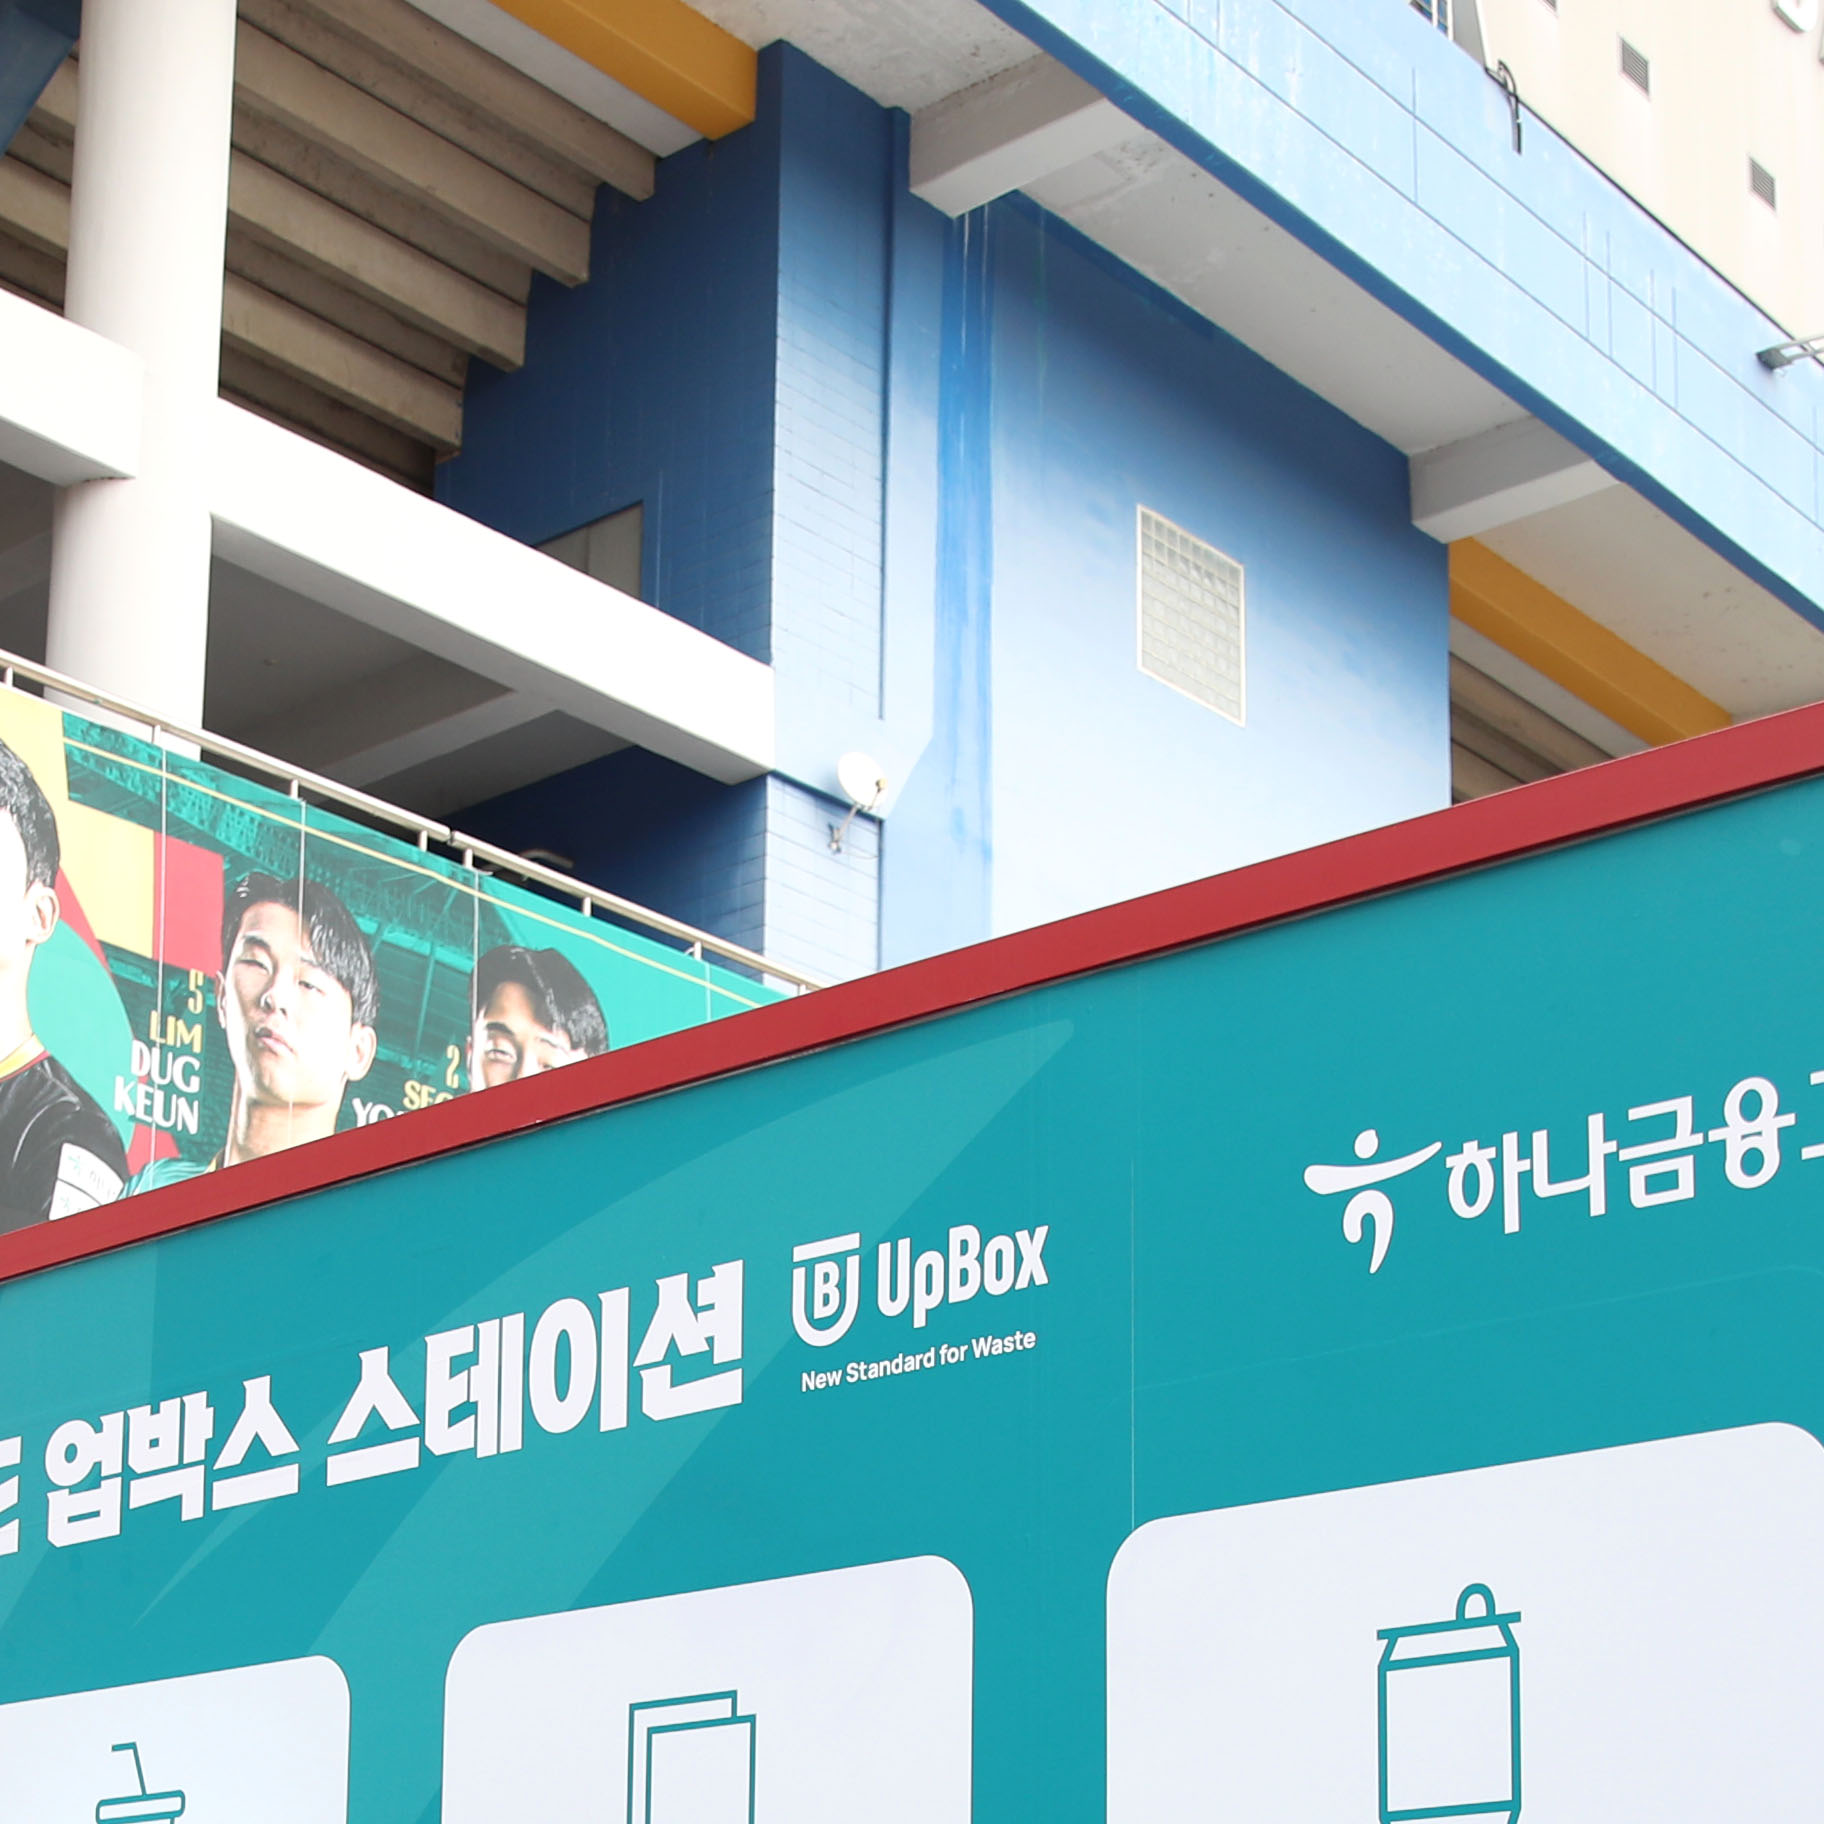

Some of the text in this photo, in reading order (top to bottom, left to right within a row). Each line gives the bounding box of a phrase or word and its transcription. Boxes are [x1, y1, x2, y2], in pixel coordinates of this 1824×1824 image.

[148, 1009, 202, 1055] LIM
[131, 1040, 200, 1090] DUG
[446, 1044, 461, 1089] 2
[114, 1078, 198, 1134] KEUN
[877, 1224, 1049, 1328] UpBox
[801, 1330, 1037, 1392] New Standard for Waste
[43, 1377, 302, 1548] 업박스
[326, 1259, 744, 1488] 스테이션
